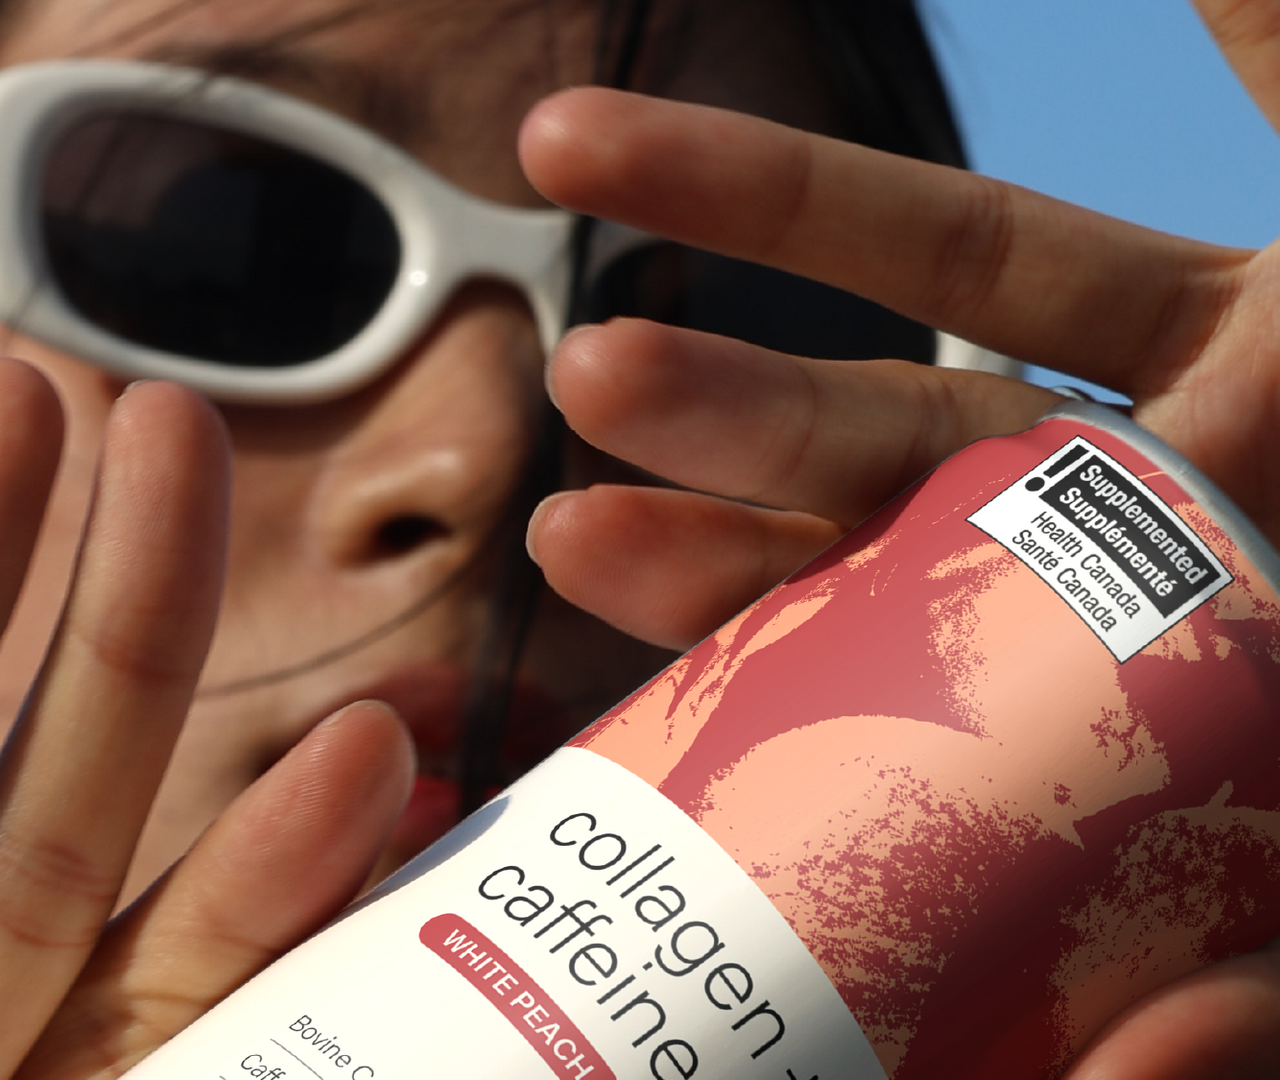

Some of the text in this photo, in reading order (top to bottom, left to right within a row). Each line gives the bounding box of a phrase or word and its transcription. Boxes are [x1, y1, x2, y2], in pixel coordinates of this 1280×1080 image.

[1031, 511, 1141, 619] Health Canada
[1059, 487, 1178, 597] Supplémenté
[1080, 464, 1208, 585] Supplemented
[1012, 529, 1117, 632] Santé Canada
[443, 929, 518, 997] WHITE
[549, 812, 786, 1060] collagen
[289, 1014, 352, 1068] Bovine
